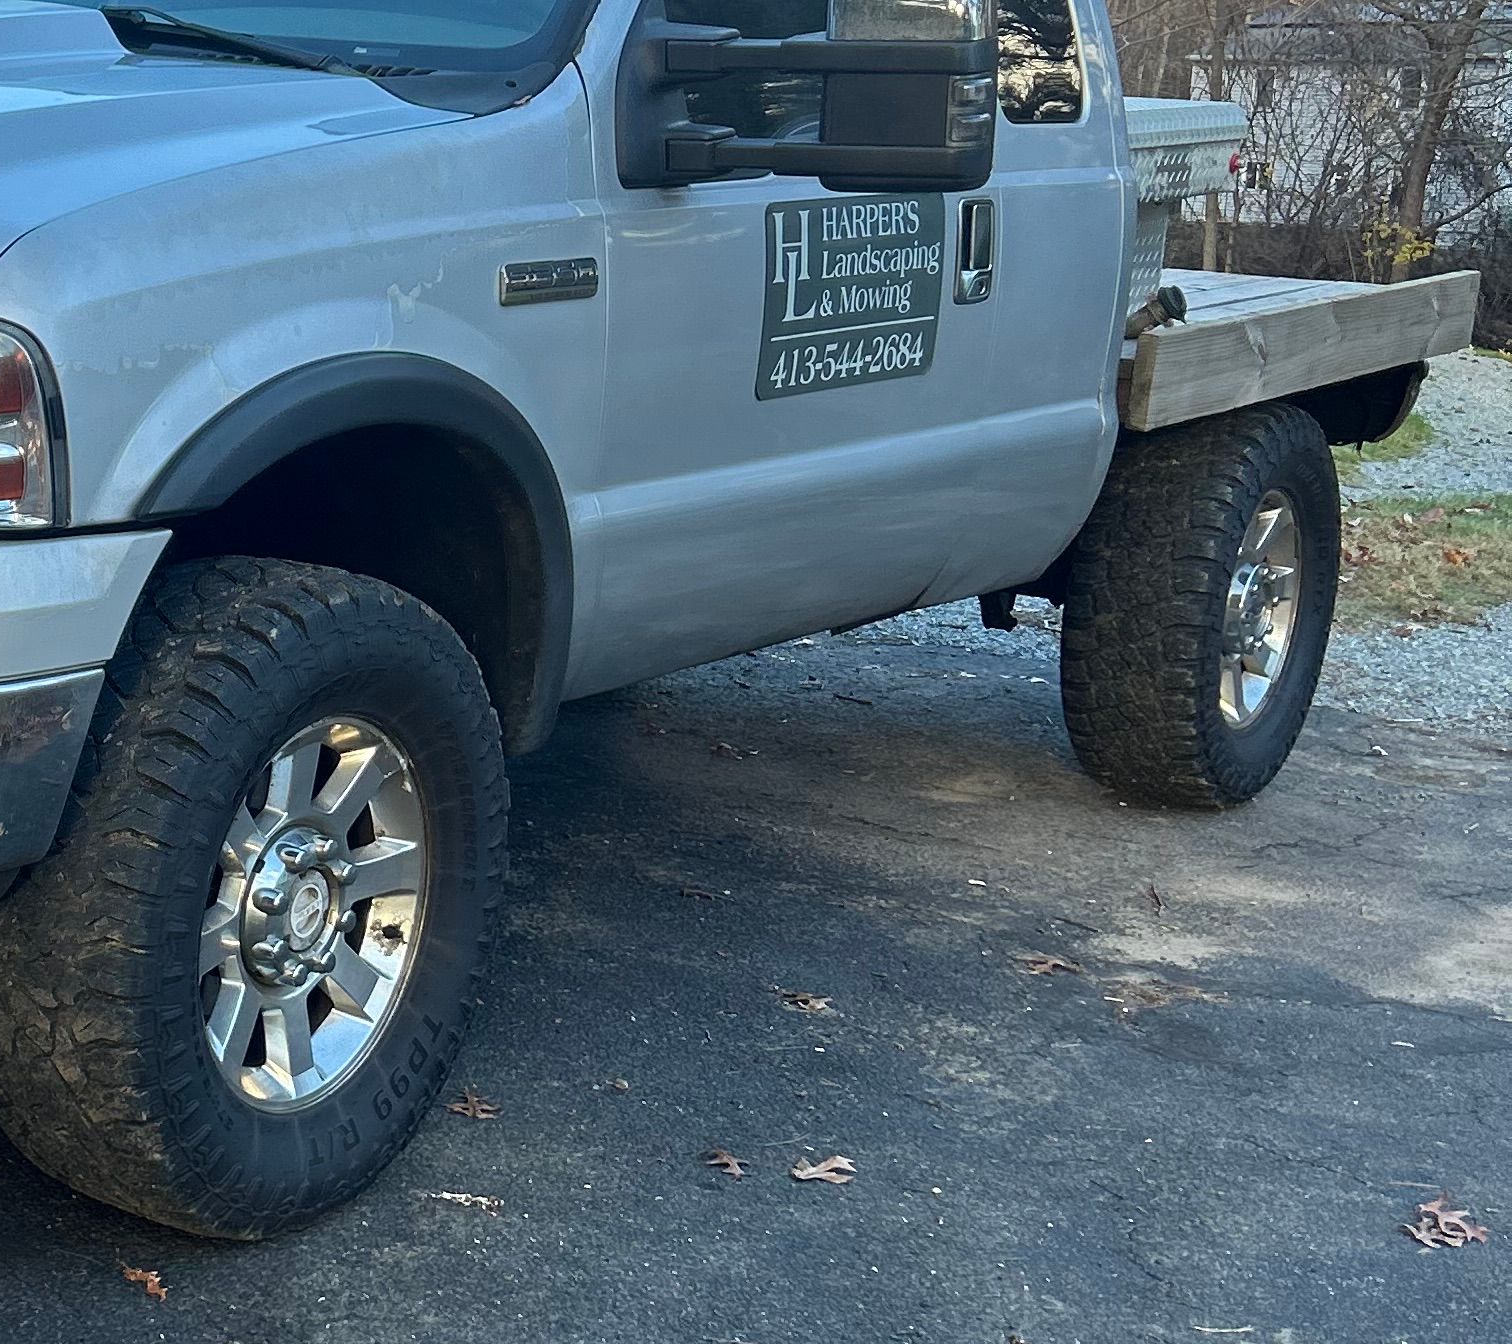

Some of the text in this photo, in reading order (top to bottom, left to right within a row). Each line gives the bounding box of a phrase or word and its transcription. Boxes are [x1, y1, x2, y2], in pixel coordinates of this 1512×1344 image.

[822, 200, 920, 241] HARPER'S
[821, 241, 941, 279] Landscaping
[819, 280, 913, 317] & Mowing
[770, 331, 924, 389] 413-544-2684
